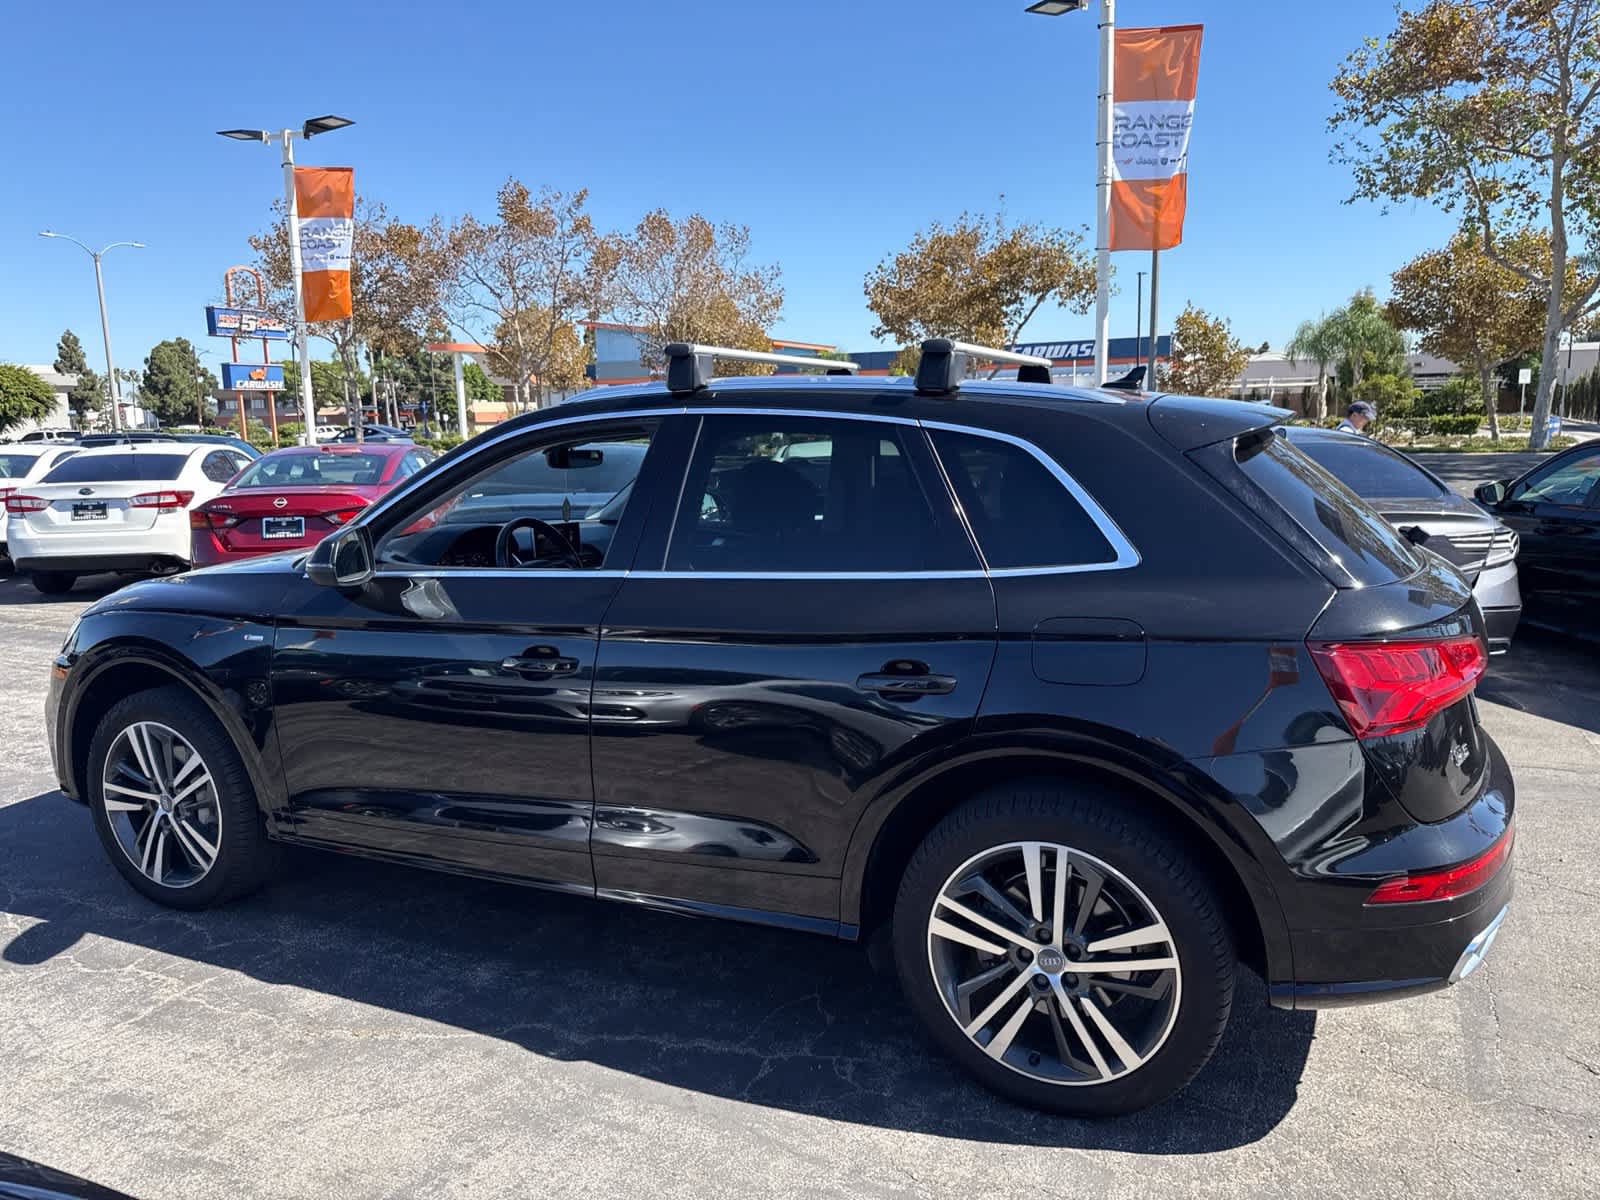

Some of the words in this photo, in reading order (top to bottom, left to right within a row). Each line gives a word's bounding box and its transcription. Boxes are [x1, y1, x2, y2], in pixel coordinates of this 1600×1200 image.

[1113, 132, 1184, 149] COAST
[1012, 343, 1096, 359] CARWAS
[236, 380, 284, 389] CARWASH
